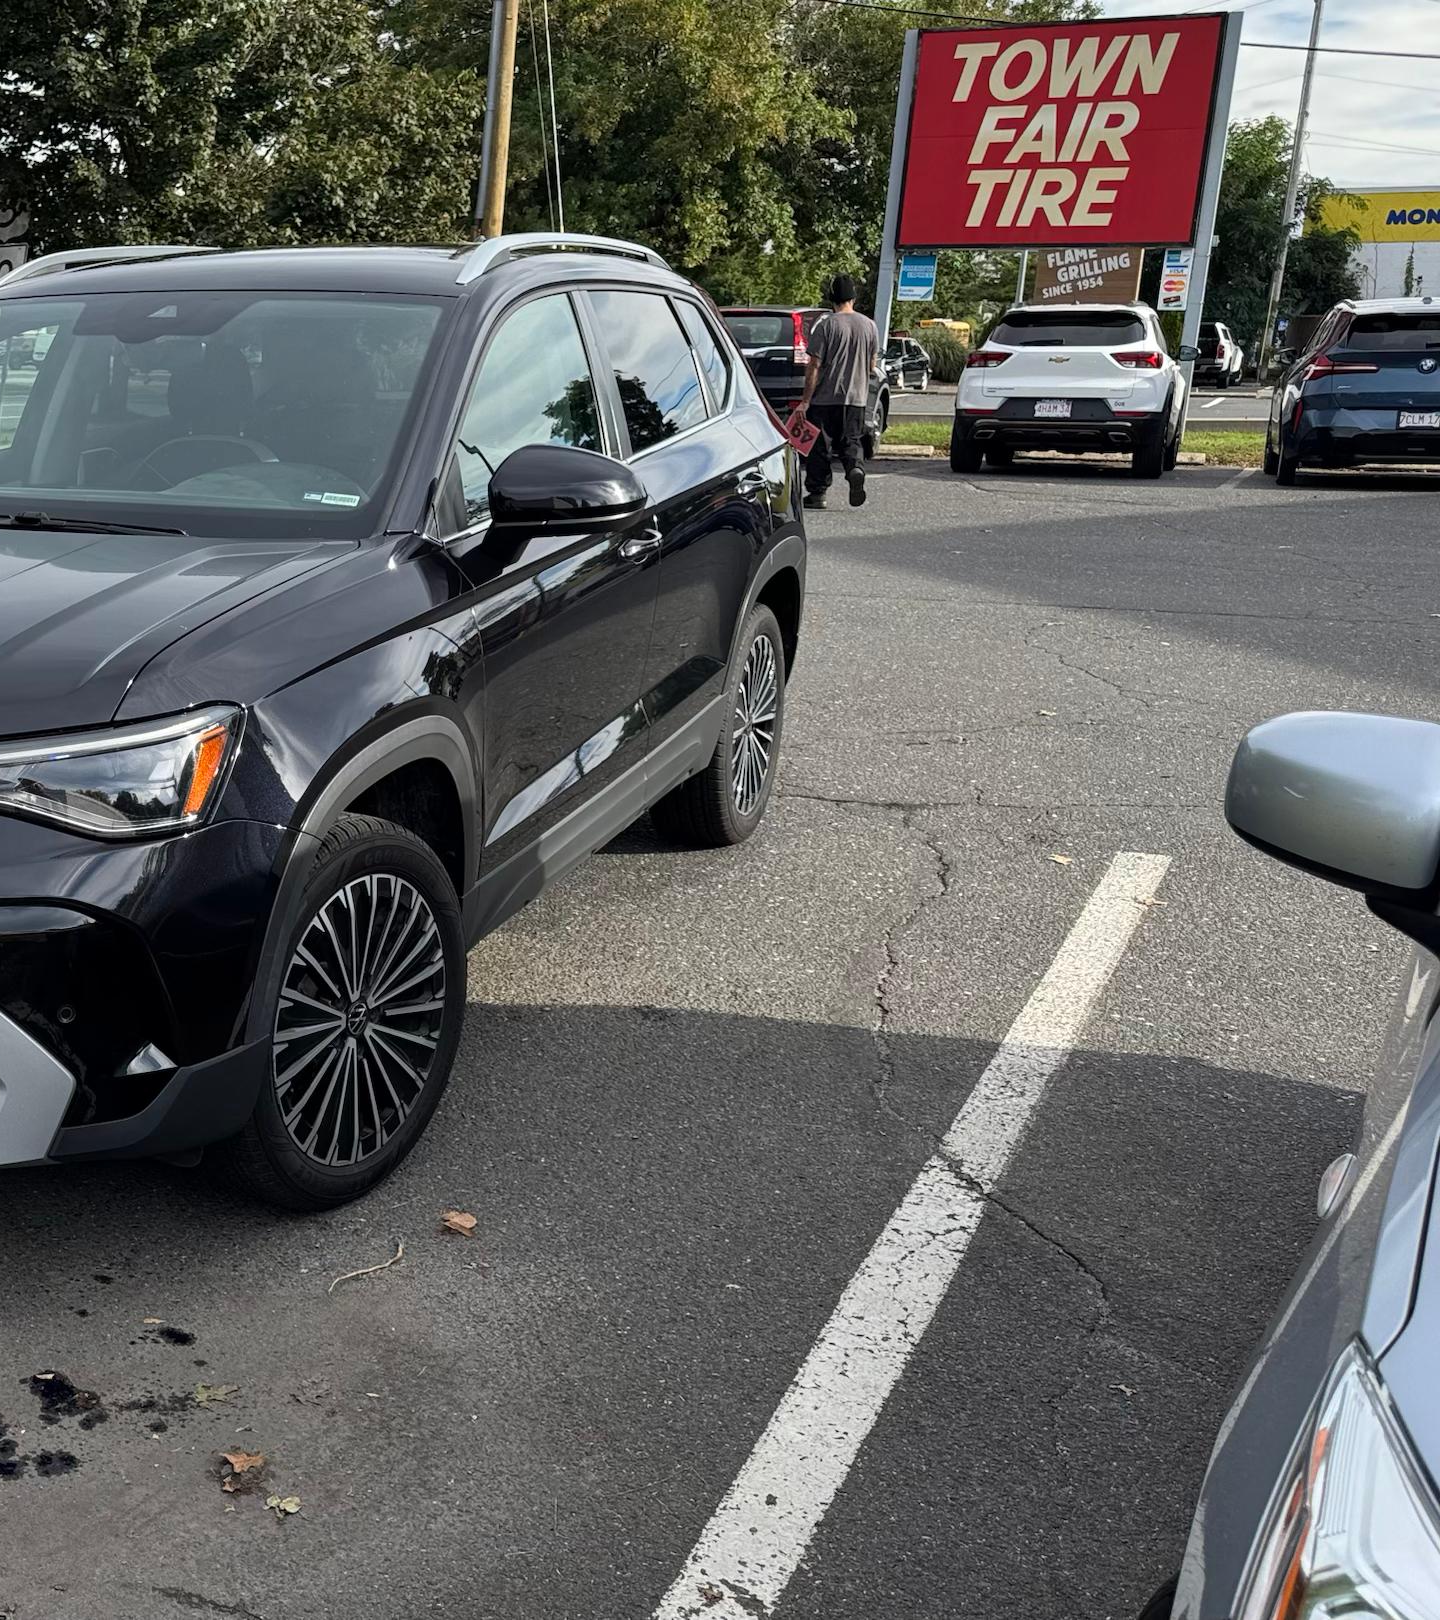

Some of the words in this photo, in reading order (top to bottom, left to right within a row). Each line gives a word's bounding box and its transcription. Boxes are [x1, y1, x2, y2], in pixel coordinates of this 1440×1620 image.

[952, 32, 1181, 102] TOWN
[967, 101, 1140, 165] FAIR
[965, 167, 1130, 227] TIRE
[1386, 208, 1440, 225] MON
[1047, 249, 1098, 269] FLAME
[1057, 252, 1131, 282] GRILLING
[1042, 283, 1073, 299] SINCE
[1076, 275, 1104, 291] 1954
